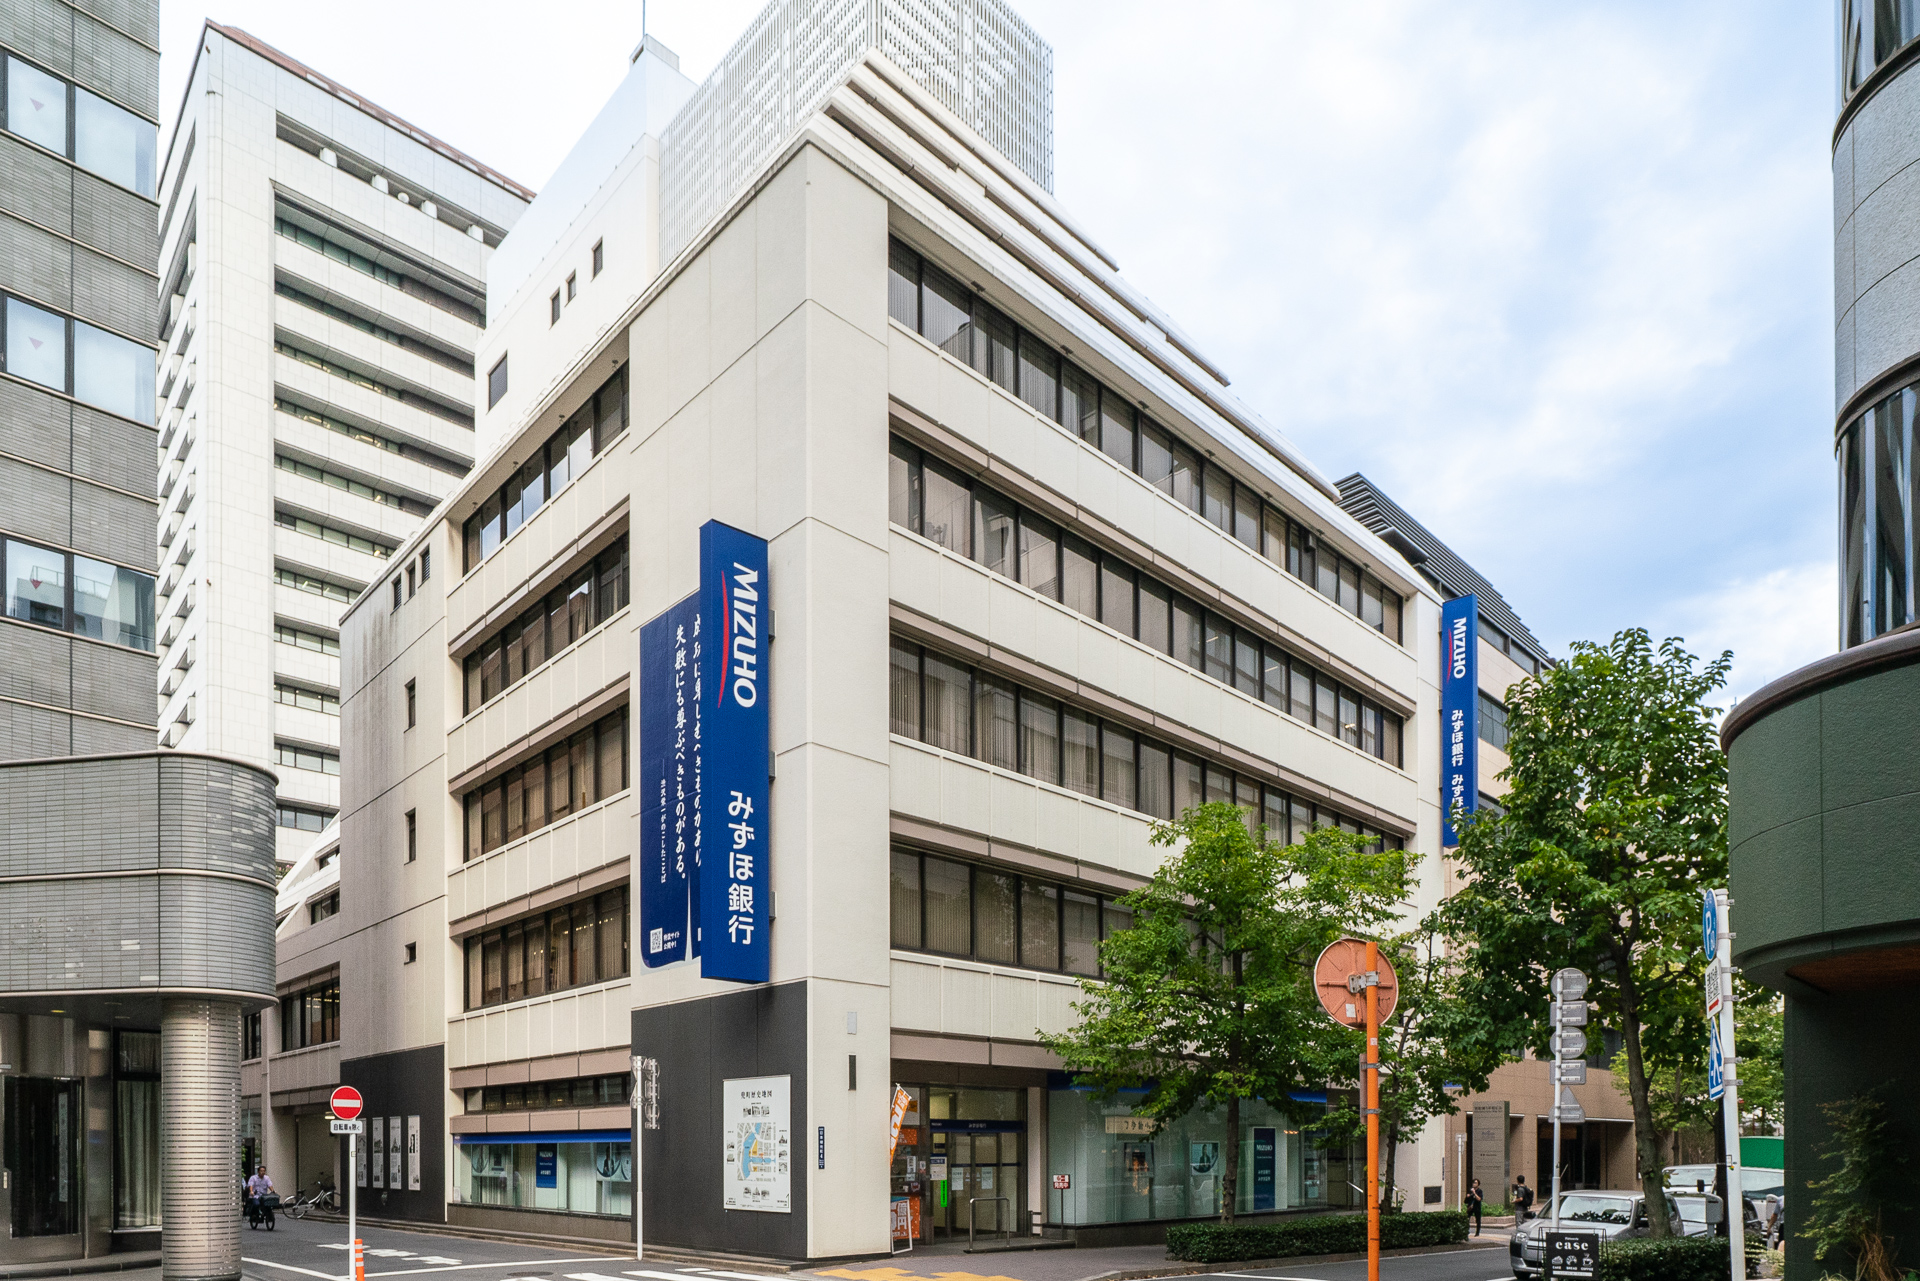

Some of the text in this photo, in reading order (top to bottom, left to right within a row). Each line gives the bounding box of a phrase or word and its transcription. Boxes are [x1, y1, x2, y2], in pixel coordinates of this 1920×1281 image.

[733, 561, 758, 708] MIZUHO
[1454, 616, 1467, 679] MIZUHO
[1451, 709, 1464, 767] みずほ銀行
[728, 790, 755, 946] みずほ銀行
[1705, 911, 1712, 955] P
[333, 1123, 360, 1131] 自転車を除く
[1555, 1241, 1589, 1250] ease
